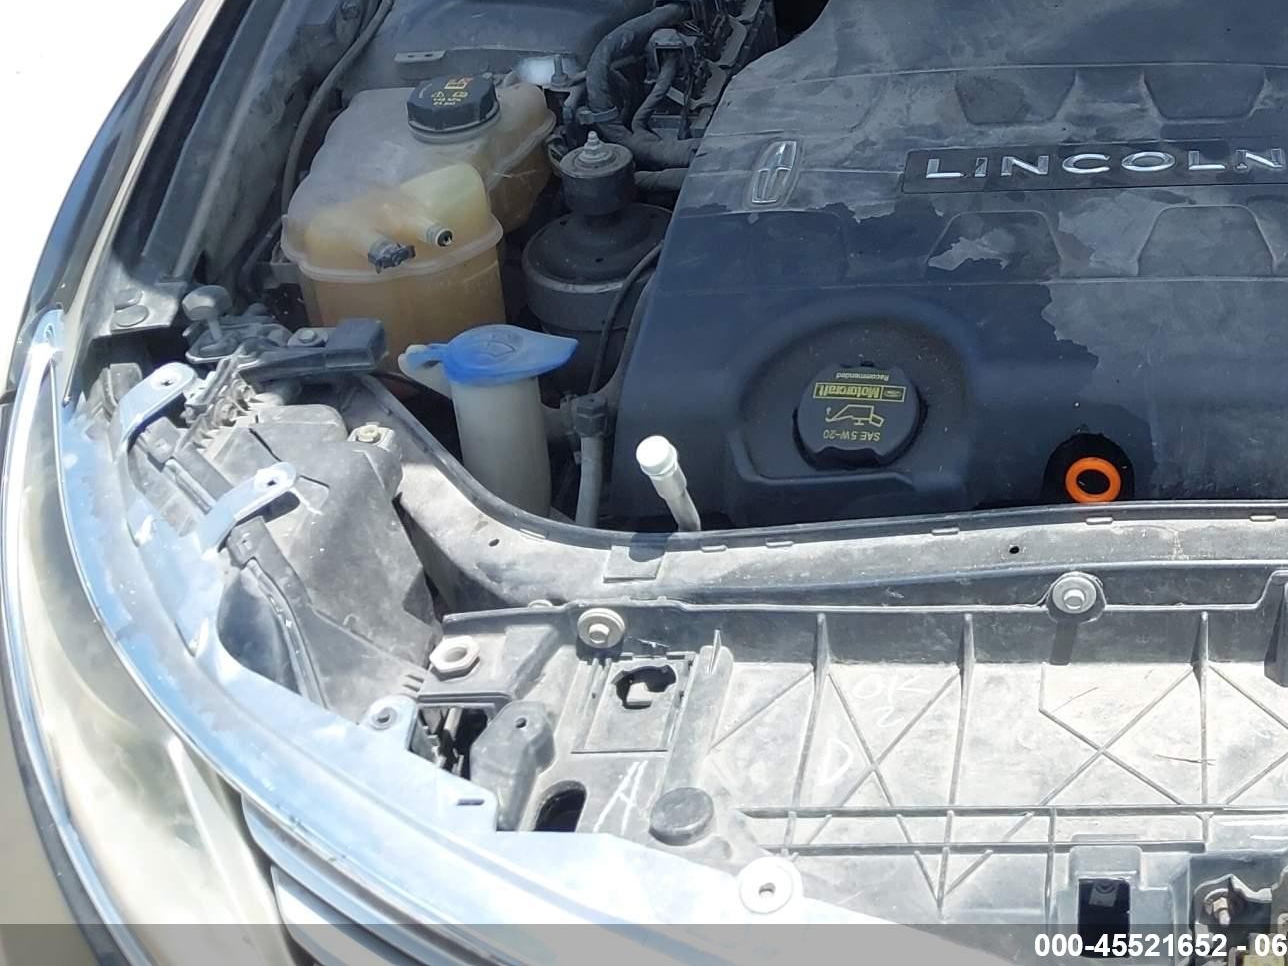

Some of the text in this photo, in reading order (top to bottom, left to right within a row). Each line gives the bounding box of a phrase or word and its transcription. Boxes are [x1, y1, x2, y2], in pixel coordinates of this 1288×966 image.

[925, 147, 1285, 179] LINCOLN
[836, 372, 890, 382] Recommended
[818, 384, 880, 399] Motorcraft
[859, 431, 881, 442] SAE
